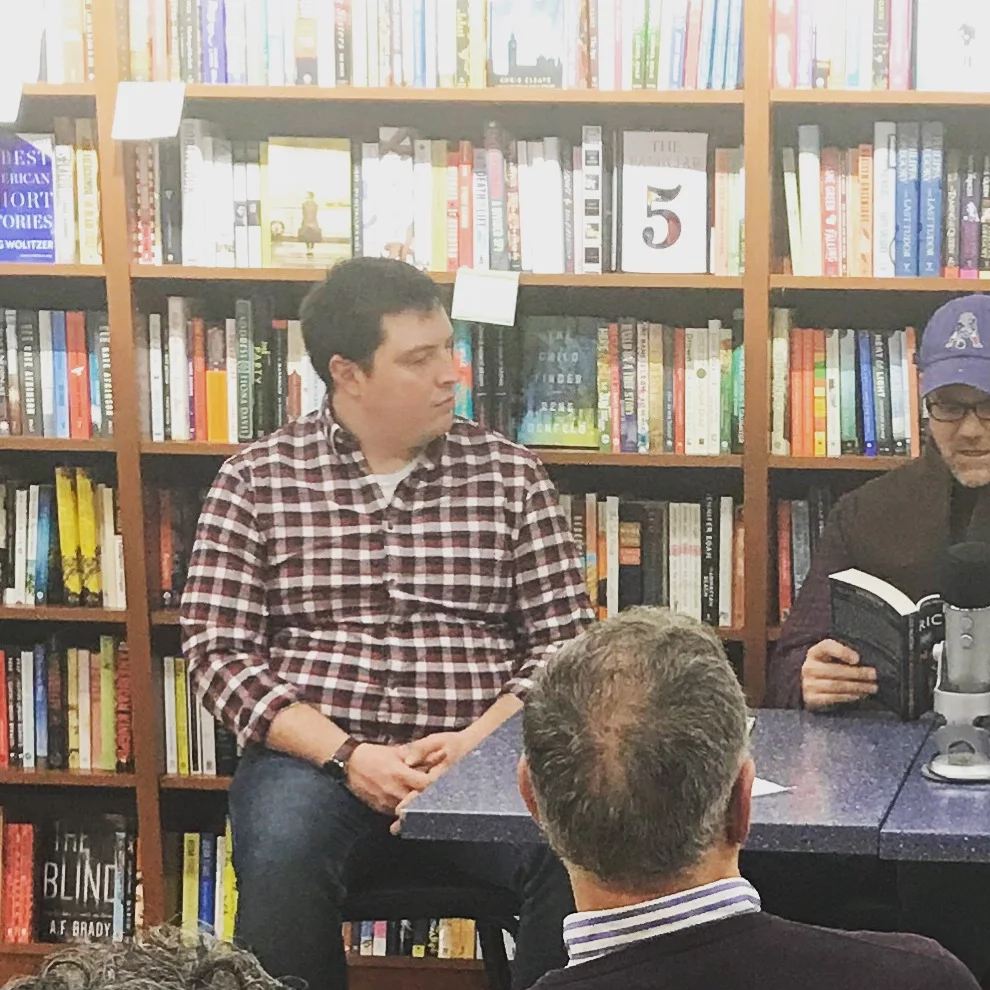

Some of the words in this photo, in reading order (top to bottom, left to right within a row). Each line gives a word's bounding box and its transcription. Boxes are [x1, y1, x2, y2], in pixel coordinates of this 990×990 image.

[643, 184, 682, 249] 5
[239, 316, 250, 359] ADDRESS
[874, 334, 884, 358] HEAT
[253, 347, 264, 384] PARTY
[538, 350, 580, 362] CHILD
[23, 371, 36, 415] ATKINSON
[535, 373, 583, 384] FINDER
[875, 371, 887, 398] LIGHT
[103, 372, 115, 416] ATKINSON
[527, 420, 587, 435] DENFELD
[705, 536, 714, 559] EGAN
[54, 820, 91, 853] THE
[44, 853, 115, 907] BLIND
[72, 921, 112, 938] BRADY
